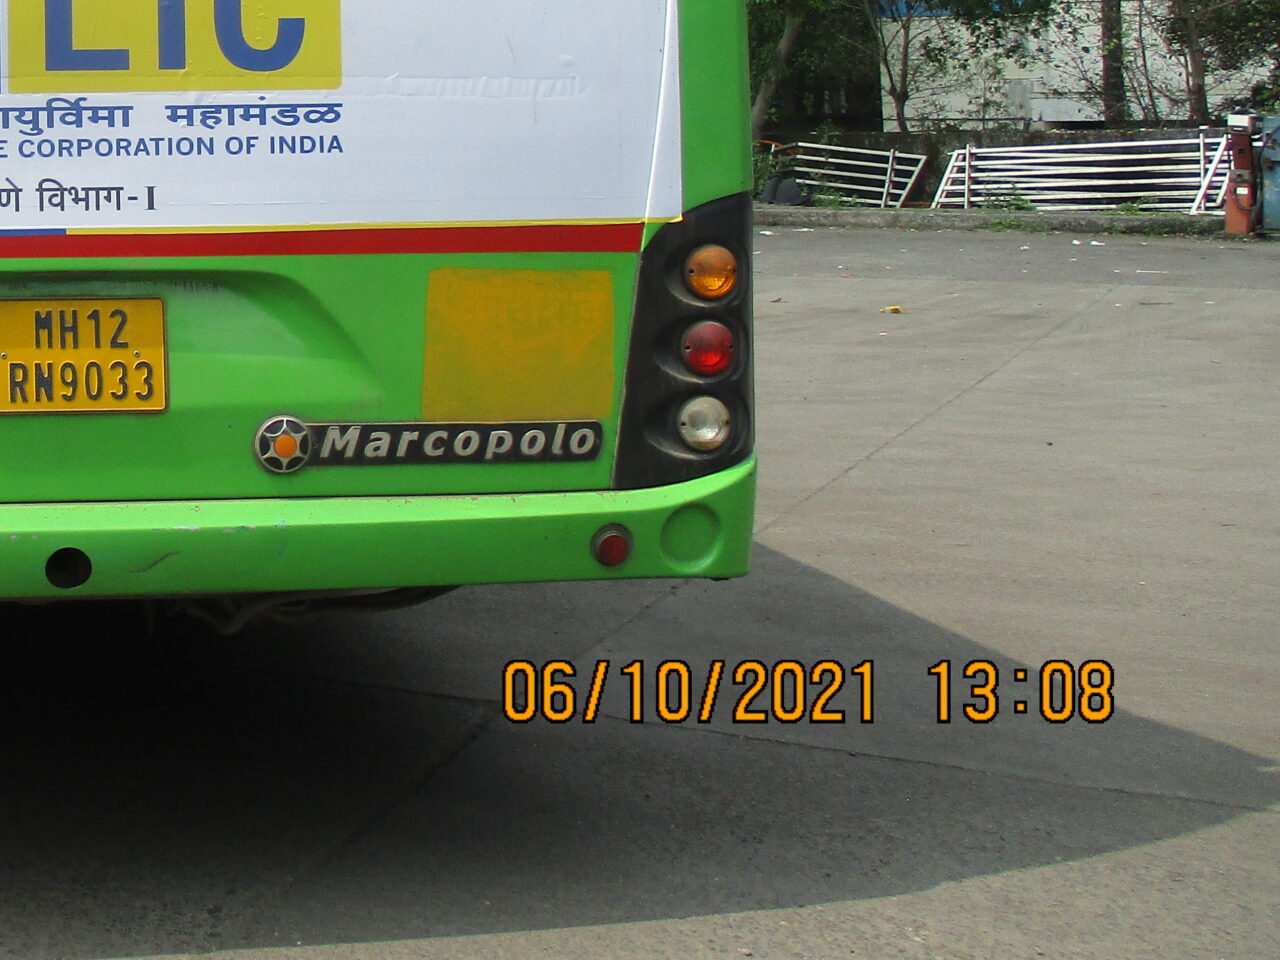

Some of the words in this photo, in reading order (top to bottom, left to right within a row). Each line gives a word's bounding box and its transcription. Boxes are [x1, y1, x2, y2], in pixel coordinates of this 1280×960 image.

[164, 96, 343, 130] महामंडळ
[17, 137, 217, 159] CORPORATION
[224, 136, 260, 156] OF
[269, 135, 344, 155] INDIA
[33, 309, 129, 350] MH12
[7, 361, 154, 403] RN9033
[319, 423, 596, 460] Marcopolo
